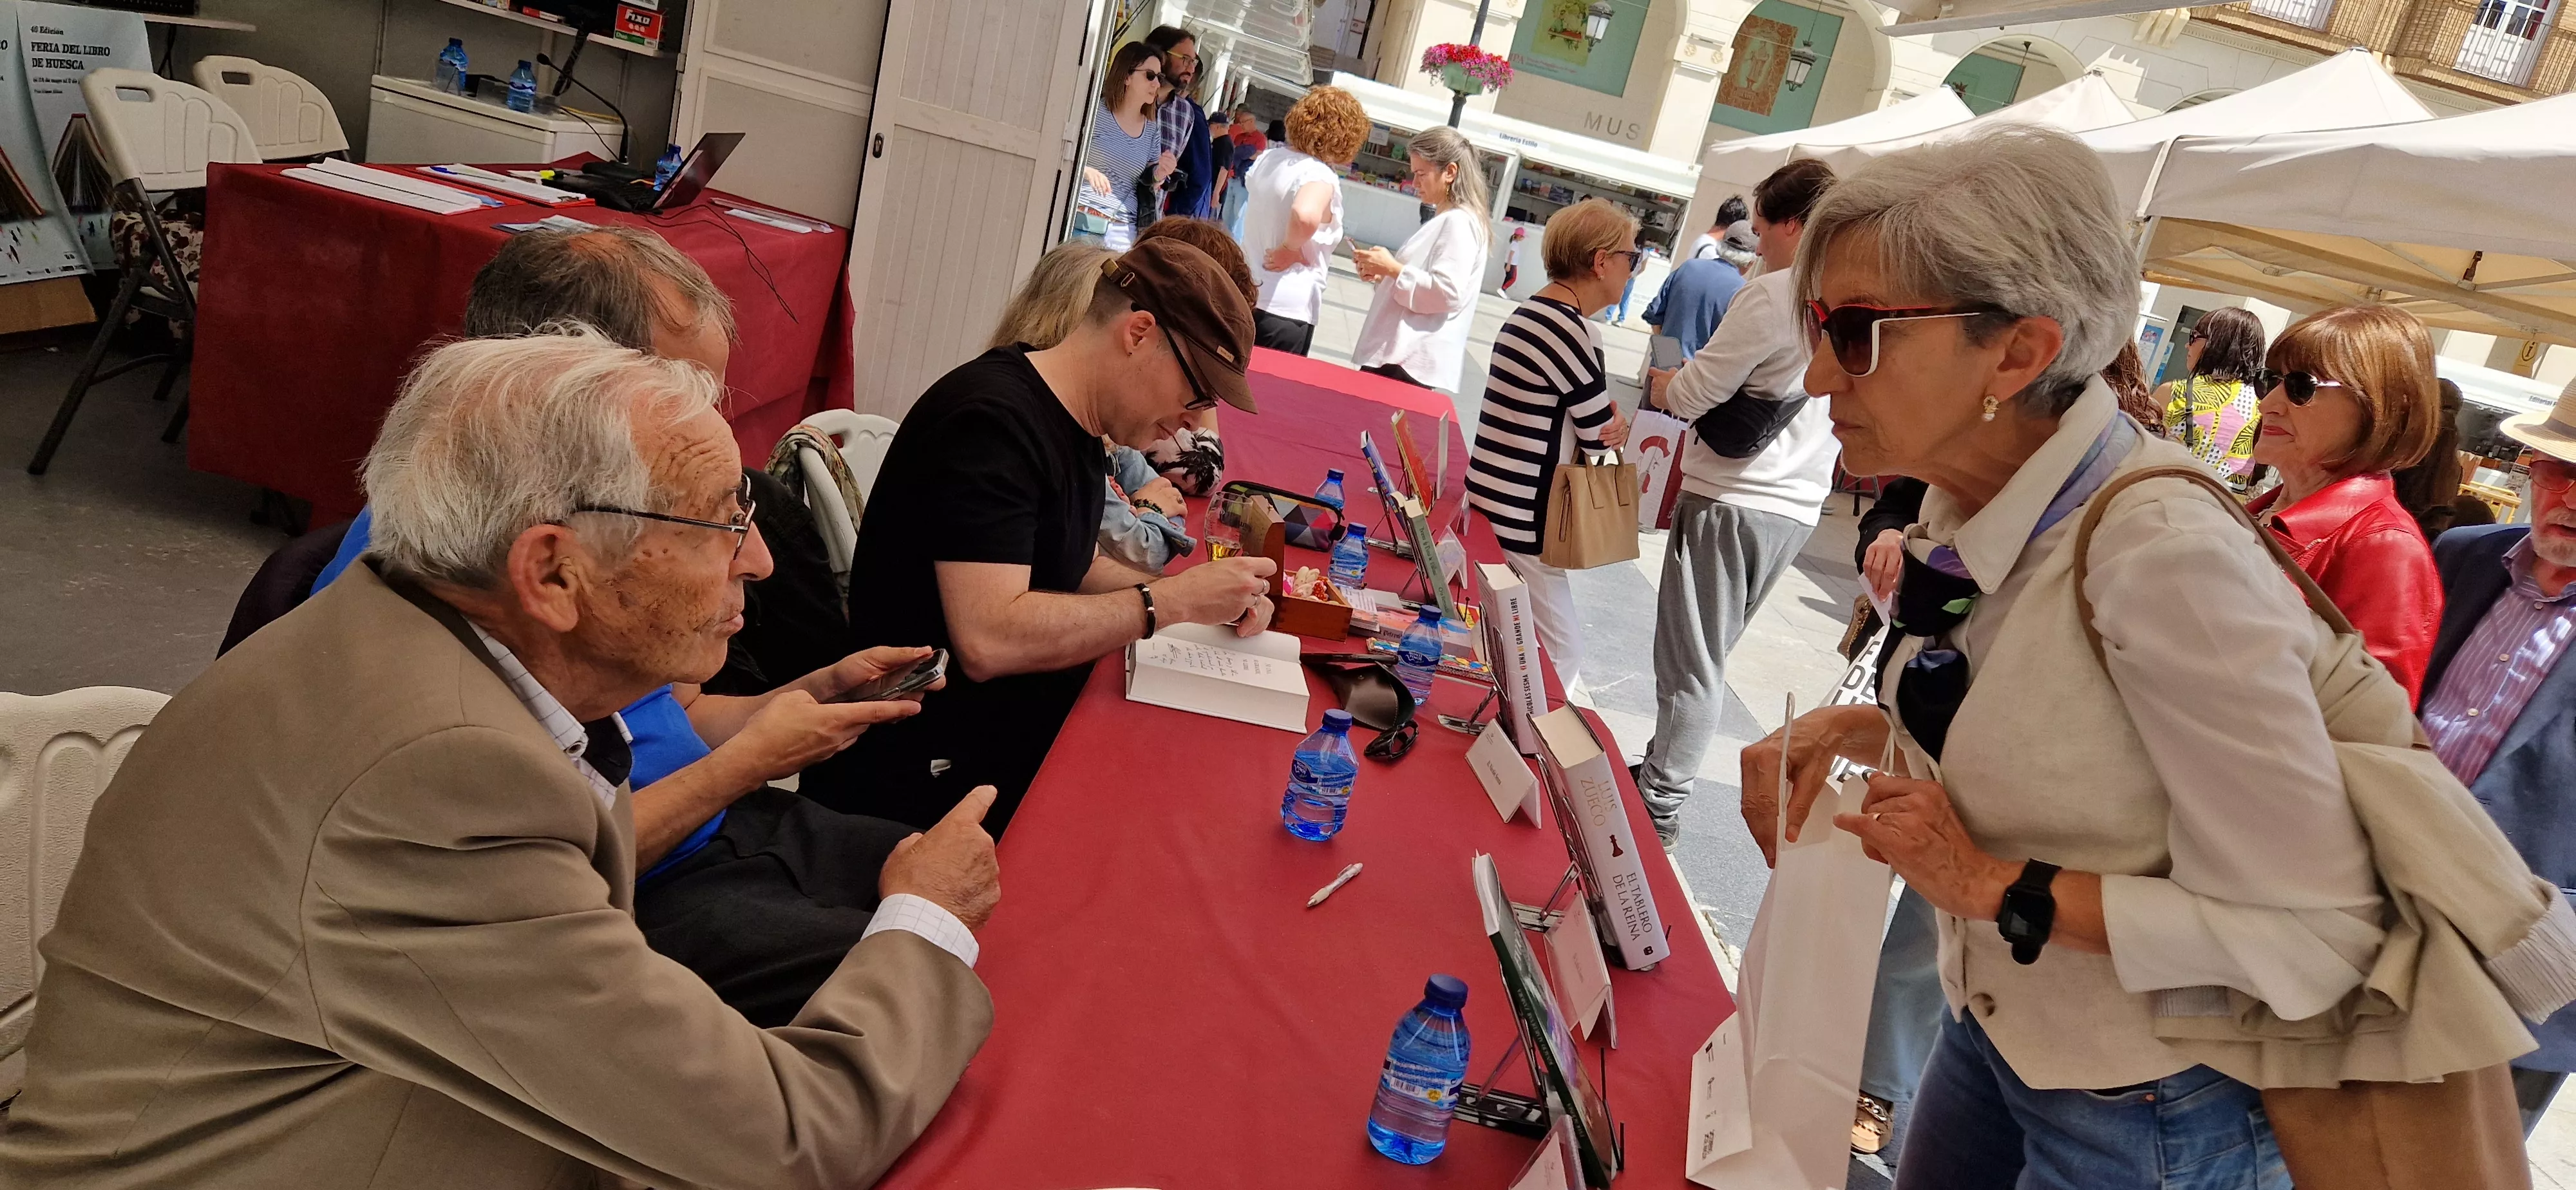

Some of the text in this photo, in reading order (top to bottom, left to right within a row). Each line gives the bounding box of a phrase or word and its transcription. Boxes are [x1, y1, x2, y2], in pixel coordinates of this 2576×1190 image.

[31, 41, 111, 57] FERIA DEL LIBRO
[32, 58, 84, 70] DE HUESCA
[1510, 597, 1519, 614] LIBRE
[1514, 622, 1524, 645] GRANDE
[1522, 674, 1531, 692] SESMA
[1580, 777, 1606, 827] ZUECO
[1597, 780, 1617, 813] LUIS
[1613, 874, 1642, 941] DE LA REINA
[1626, 872, 1653, 934] EL TABLERO
